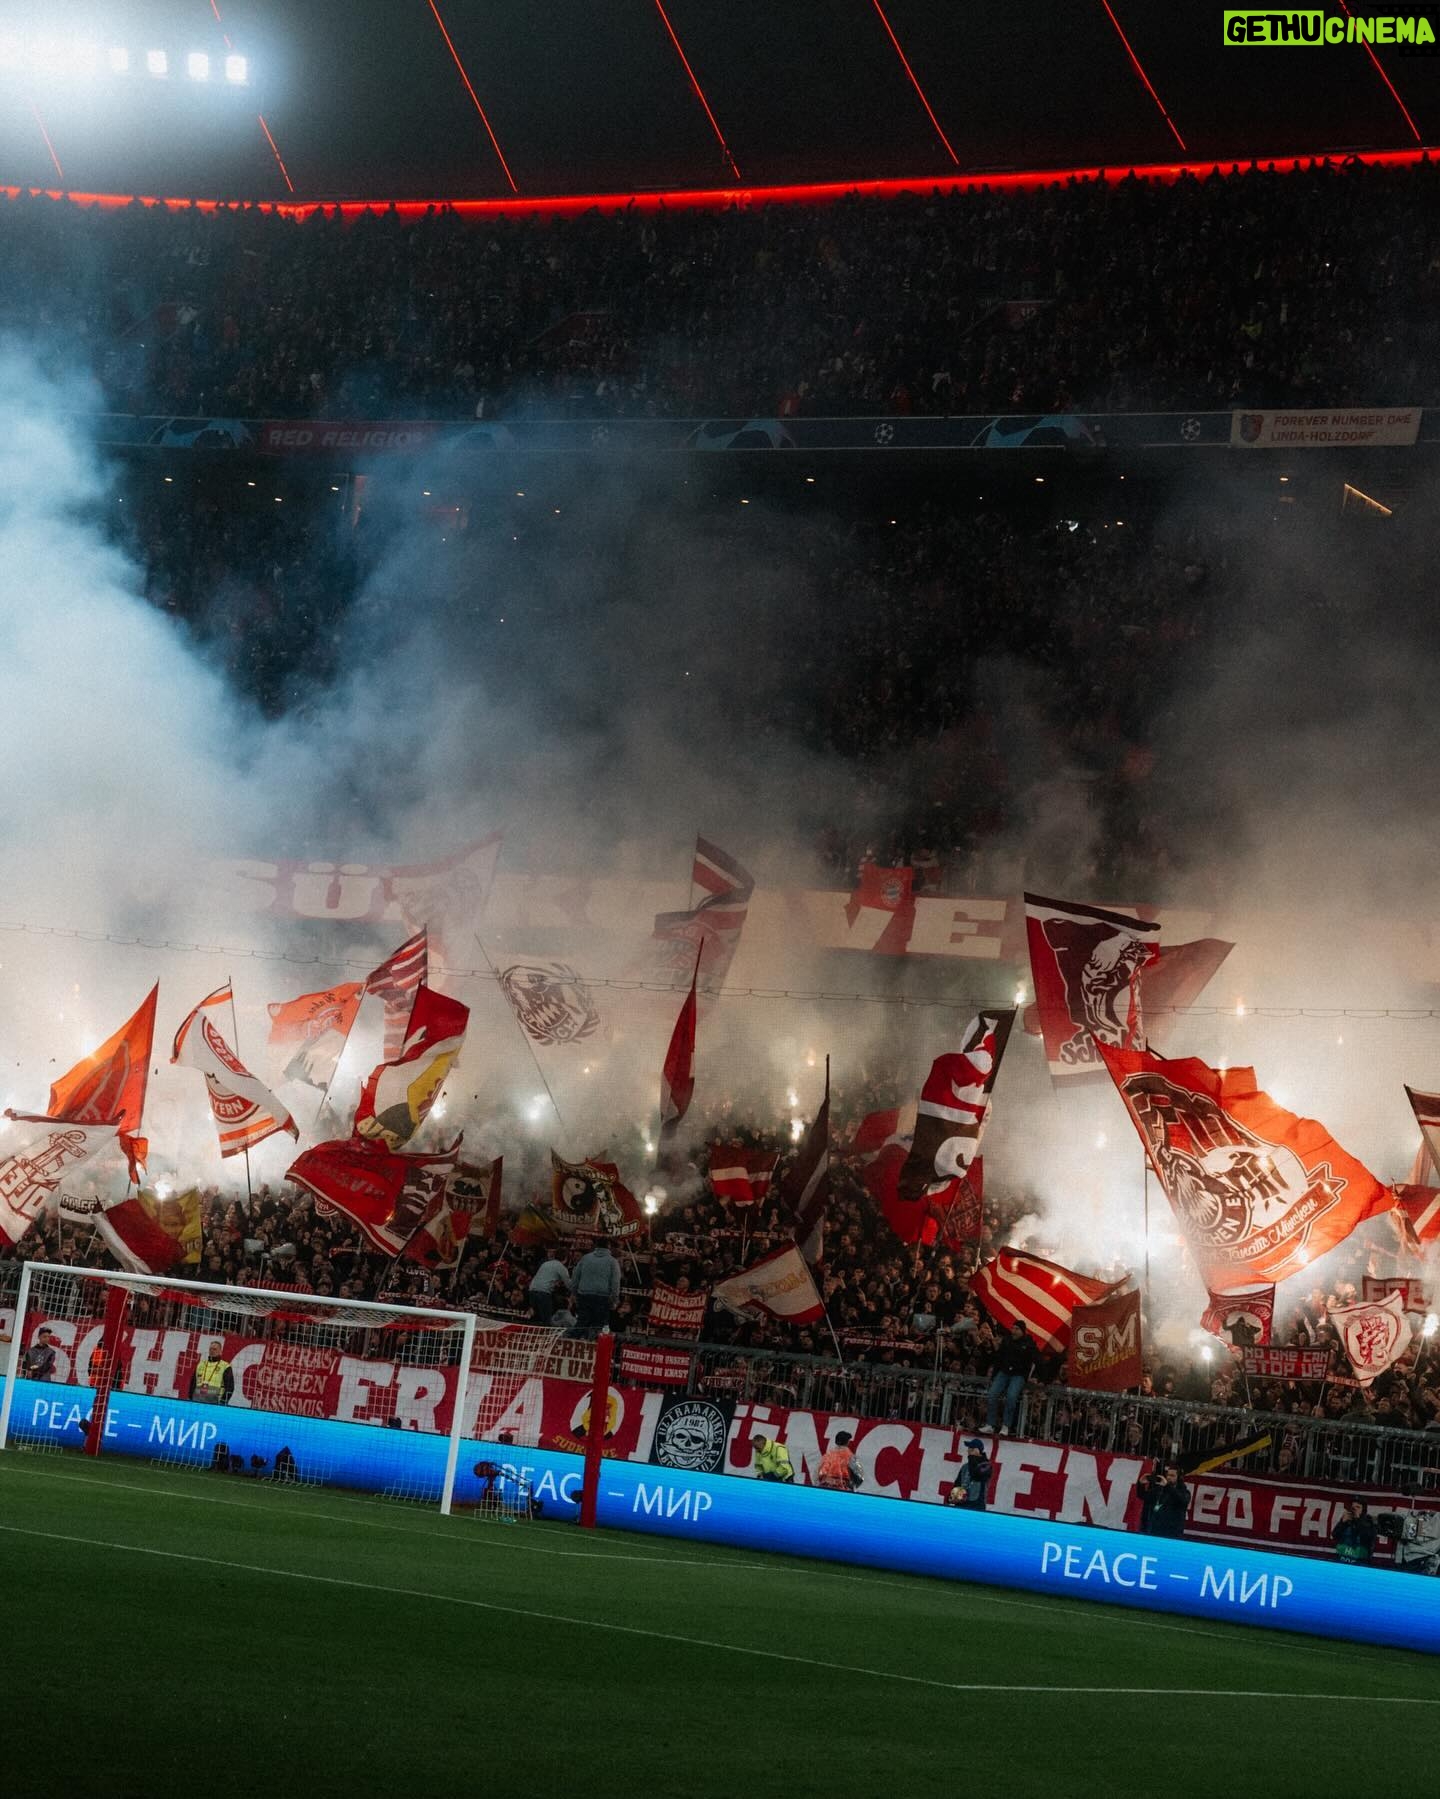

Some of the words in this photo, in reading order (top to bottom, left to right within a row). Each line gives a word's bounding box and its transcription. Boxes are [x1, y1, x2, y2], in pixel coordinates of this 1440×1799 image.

[1274, 415, 1328, 426] FOREVER
[1331, 414, 1383, 425] NUMBER
[269, 429, 313, 446] RED
[650, 1303, 705, 1323] MÜNCHEN
[1077, 1312, 1137, 1362] SM
[1245, 1348, 1265, 1359] NO
[1302, 1351, 1329, 1363] CAN
[1246, 1359, 1295, 1376] STOP
[258, 1365, 328, 1395] GEGEN
[684, 1418, 705, 1428] 1987
[632, 1482, 713, 1522] МИР
[1041, 1541, 1159, 1591] PEACE
[1199, 1565, 1294, 1609] МИР
